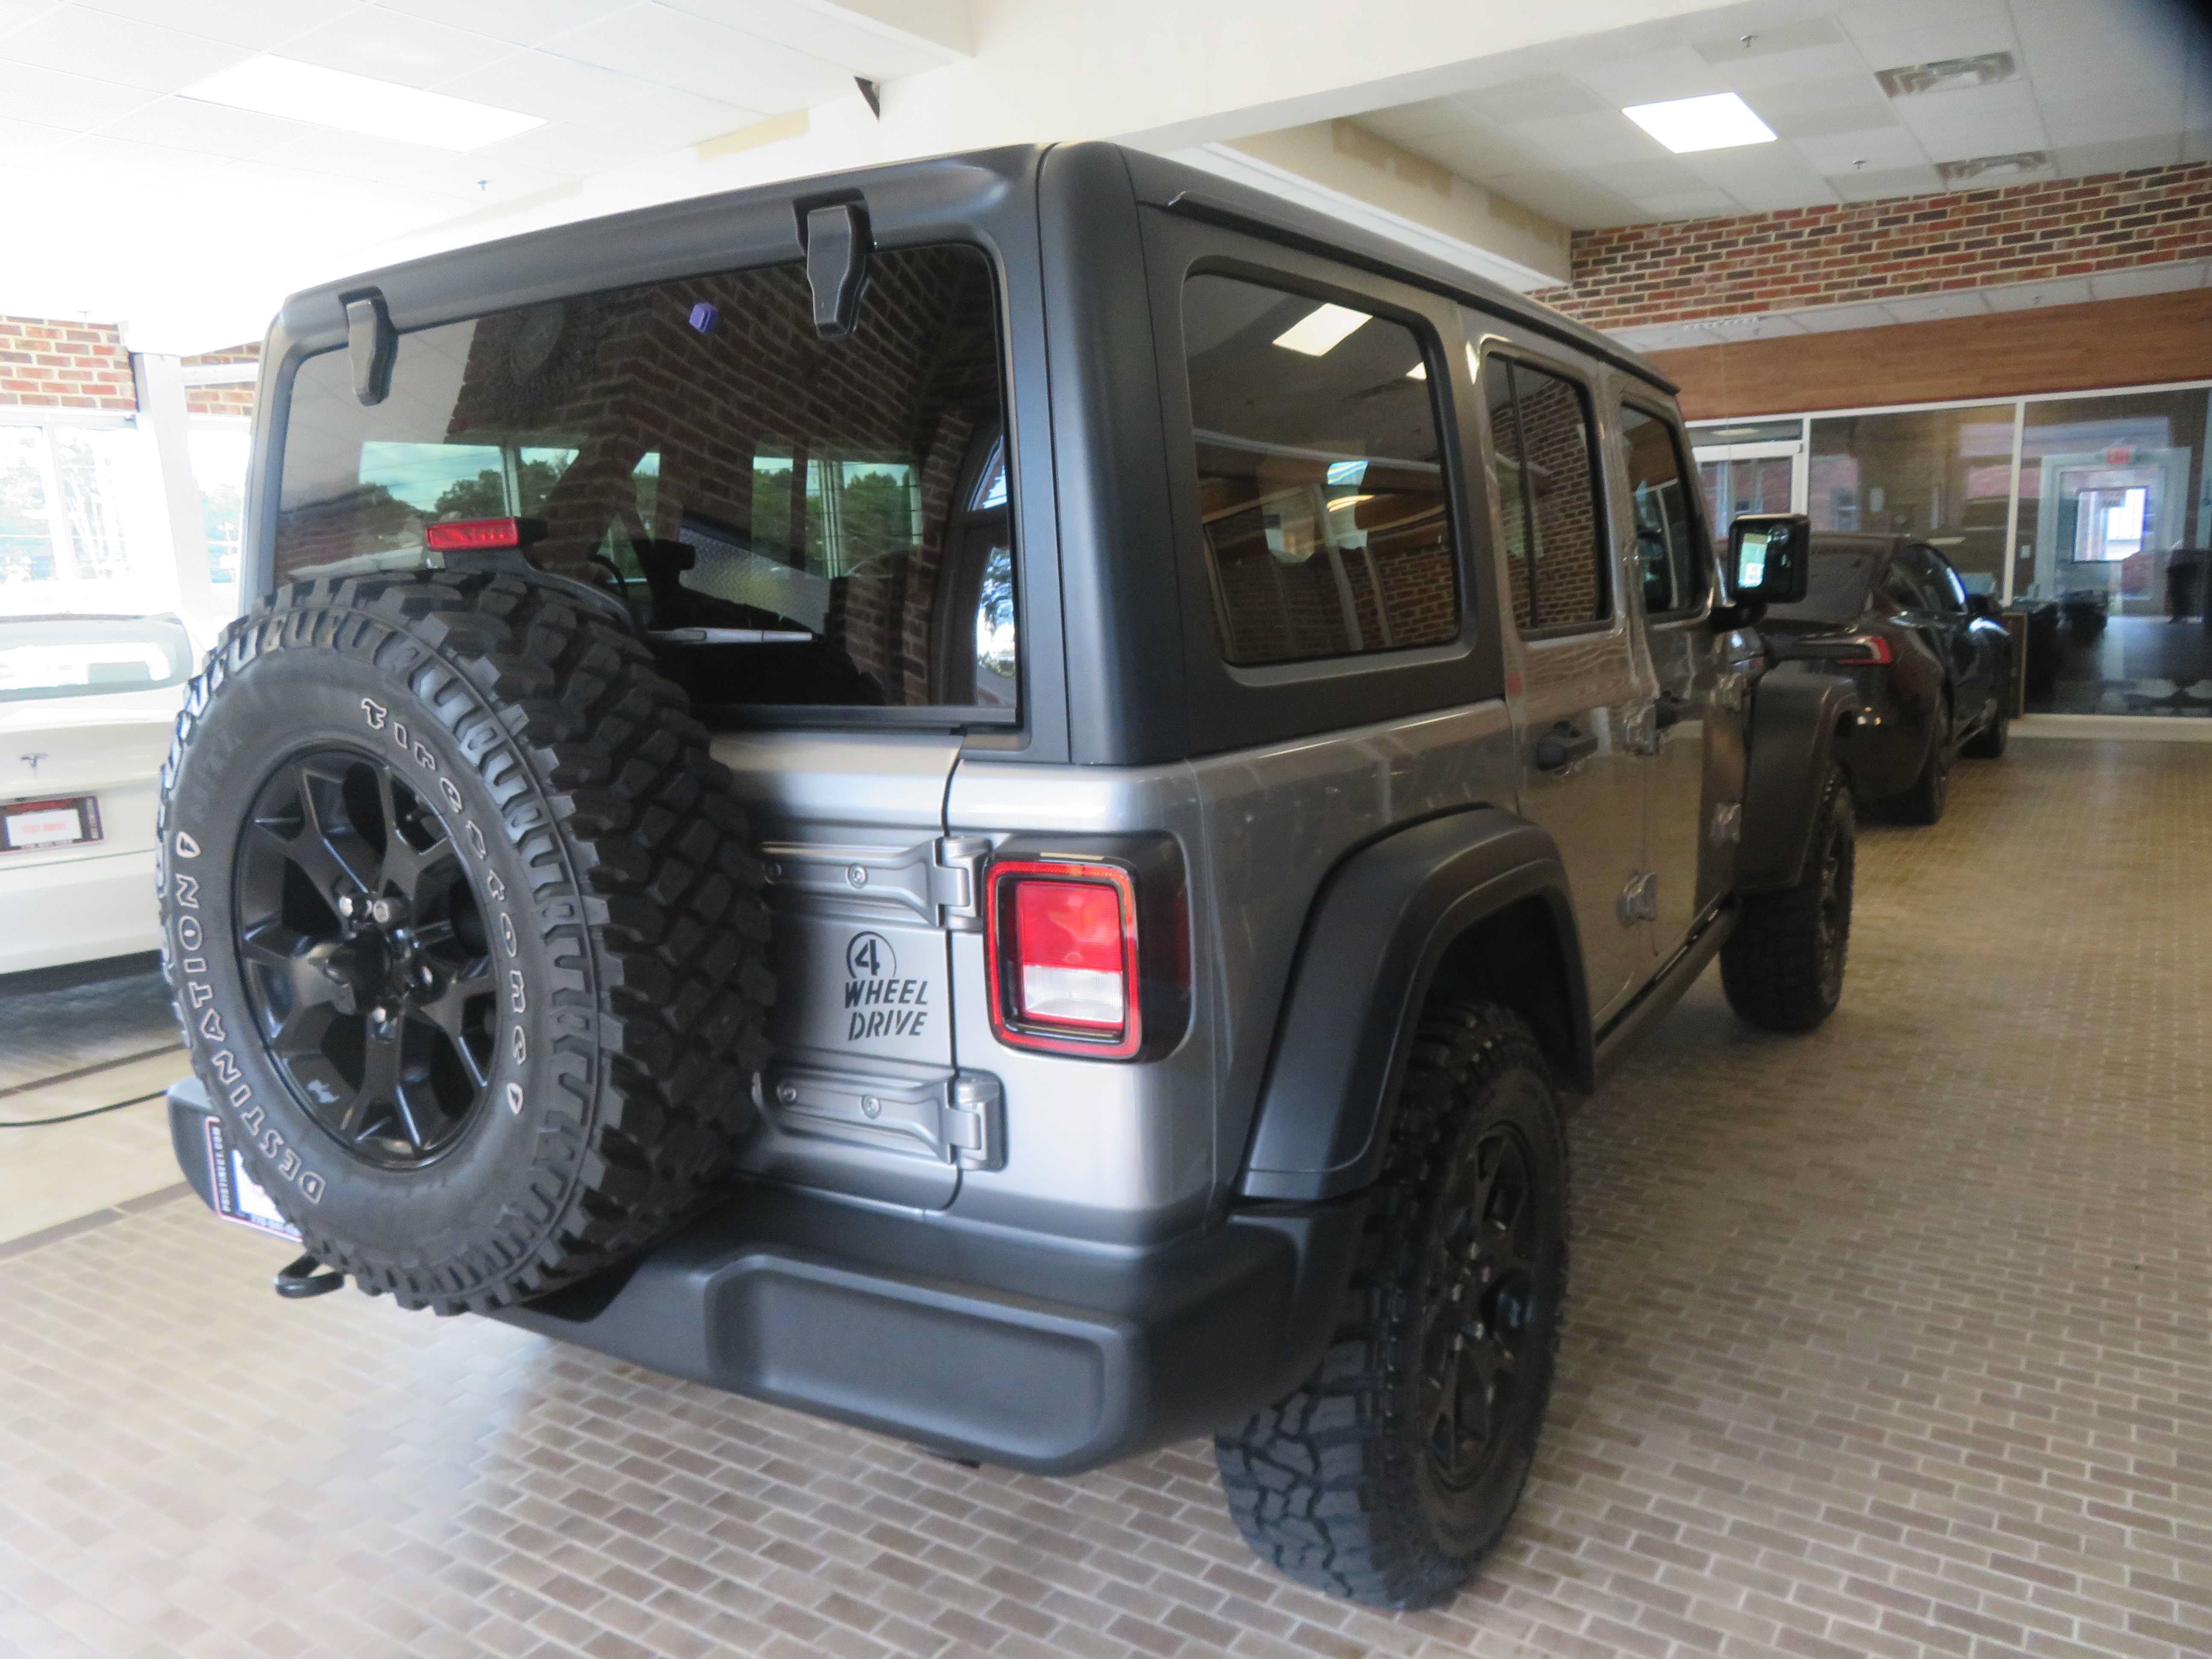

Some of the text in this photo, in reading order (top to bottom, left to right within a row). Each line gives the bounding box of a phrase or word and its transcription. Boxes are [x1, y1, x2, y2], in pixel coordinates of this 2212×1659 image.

[844, 979, 928, 1009] WHEEL
[175, 873, 326, 1204] DESTINATION
[848, 1010, 928, 1041] DRIVE
